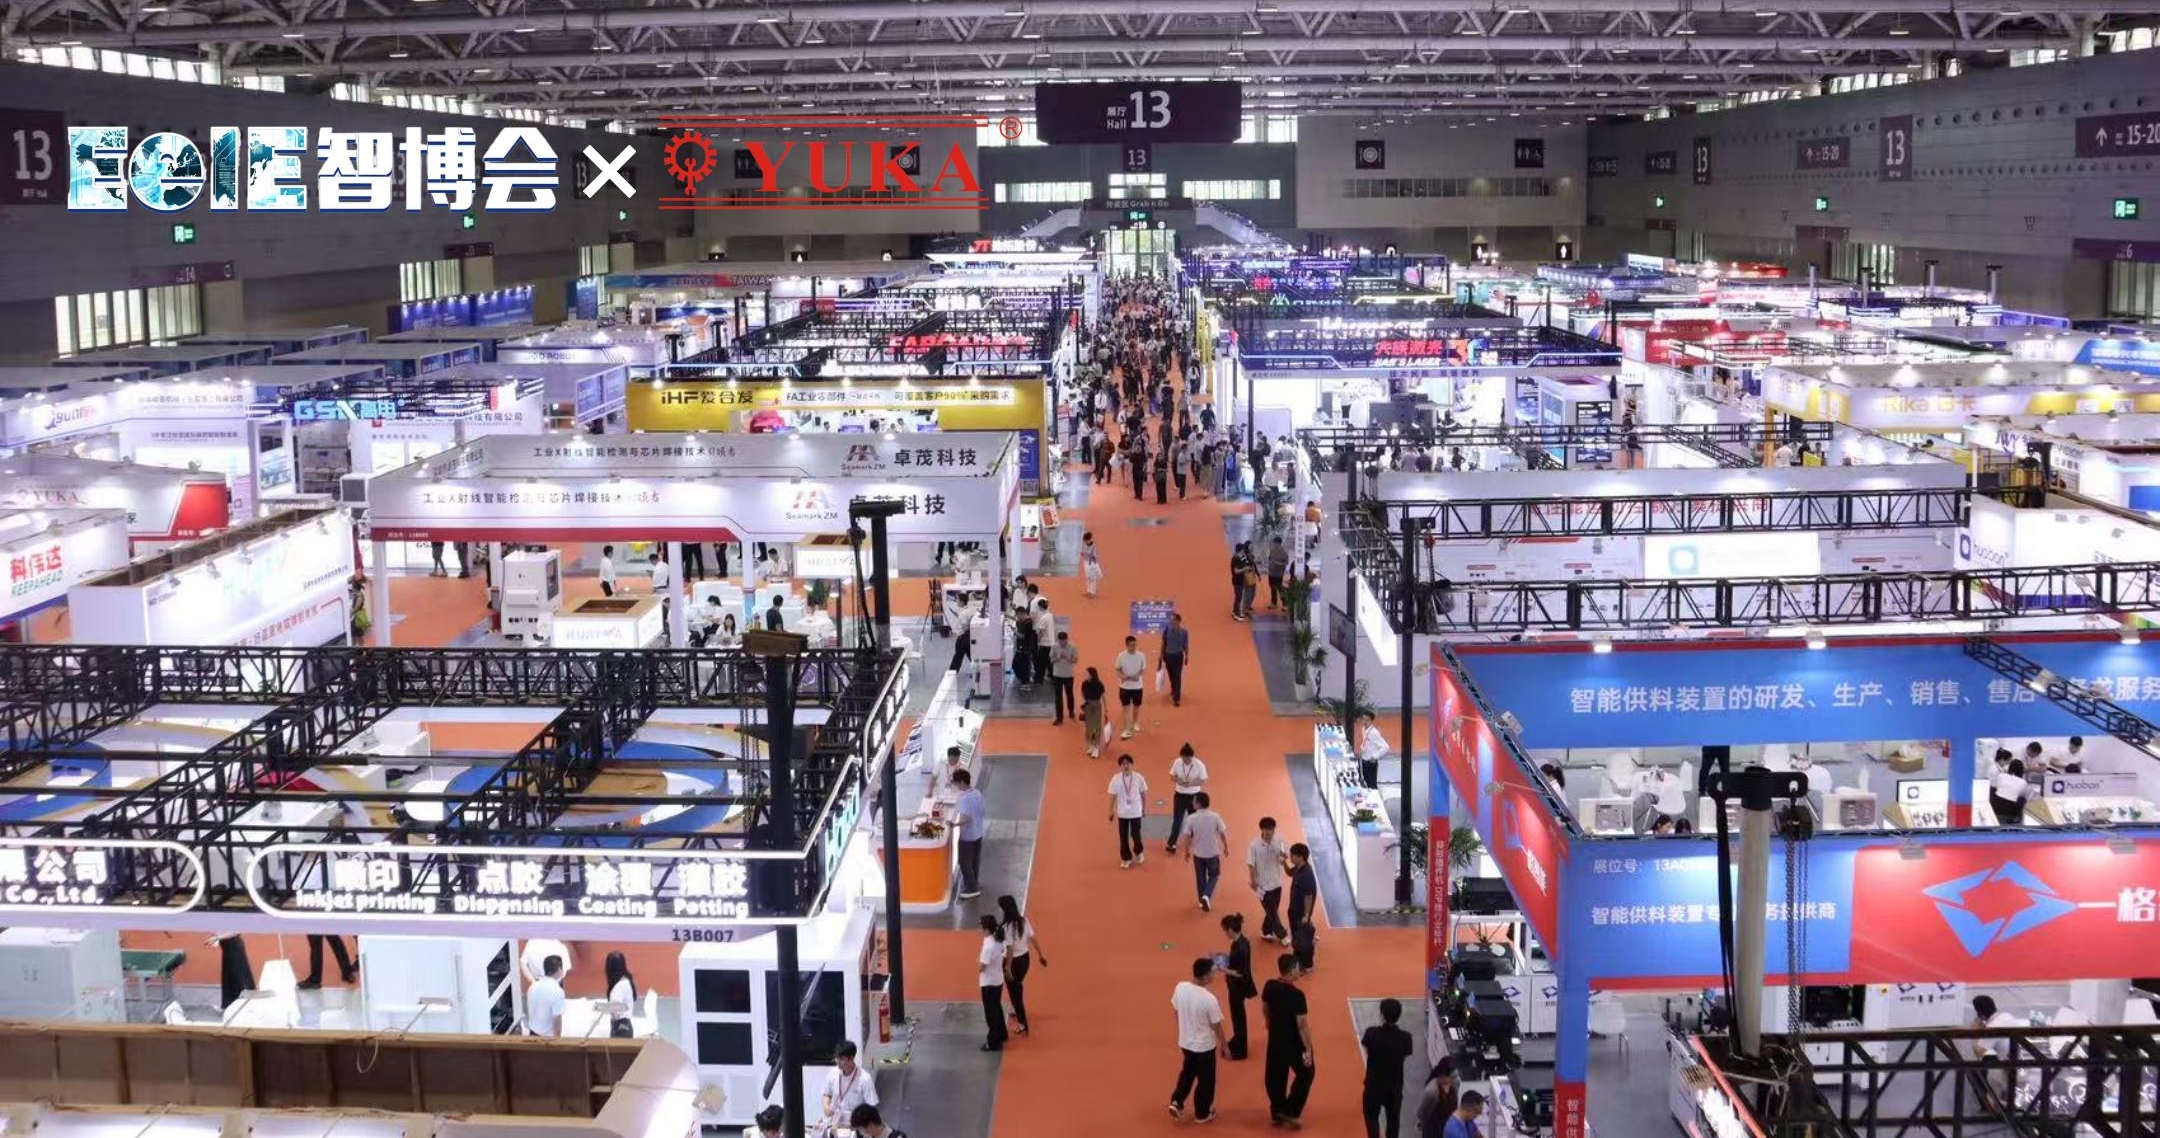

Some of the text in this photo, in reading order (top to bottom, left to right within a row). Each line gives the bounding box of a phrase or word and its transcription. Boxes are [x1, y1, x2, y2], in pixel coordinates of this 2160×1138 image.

[1130, 90, 1172, 129] 13
[1107, 119, 1127, 129] Hall
[12, 128, 54, 182] 13
[1127, 148, 1147, 166] 13
[1885, 129, 1906, 167] 13
[1696, 146, 1709, 173] 13
[660, 390, 700, 405] iHF
[1884, 394, 1929, 414] Rika
[893, 447, 978, 467] 卓茂科技
[356, 892, 437, 914] printing
[454, 894, 565, 917] Dispensing
[577, 896, 658, 918] Coating
[672, 897, 750, 919] Potting
[671, 928, 735, 943] 13B007
